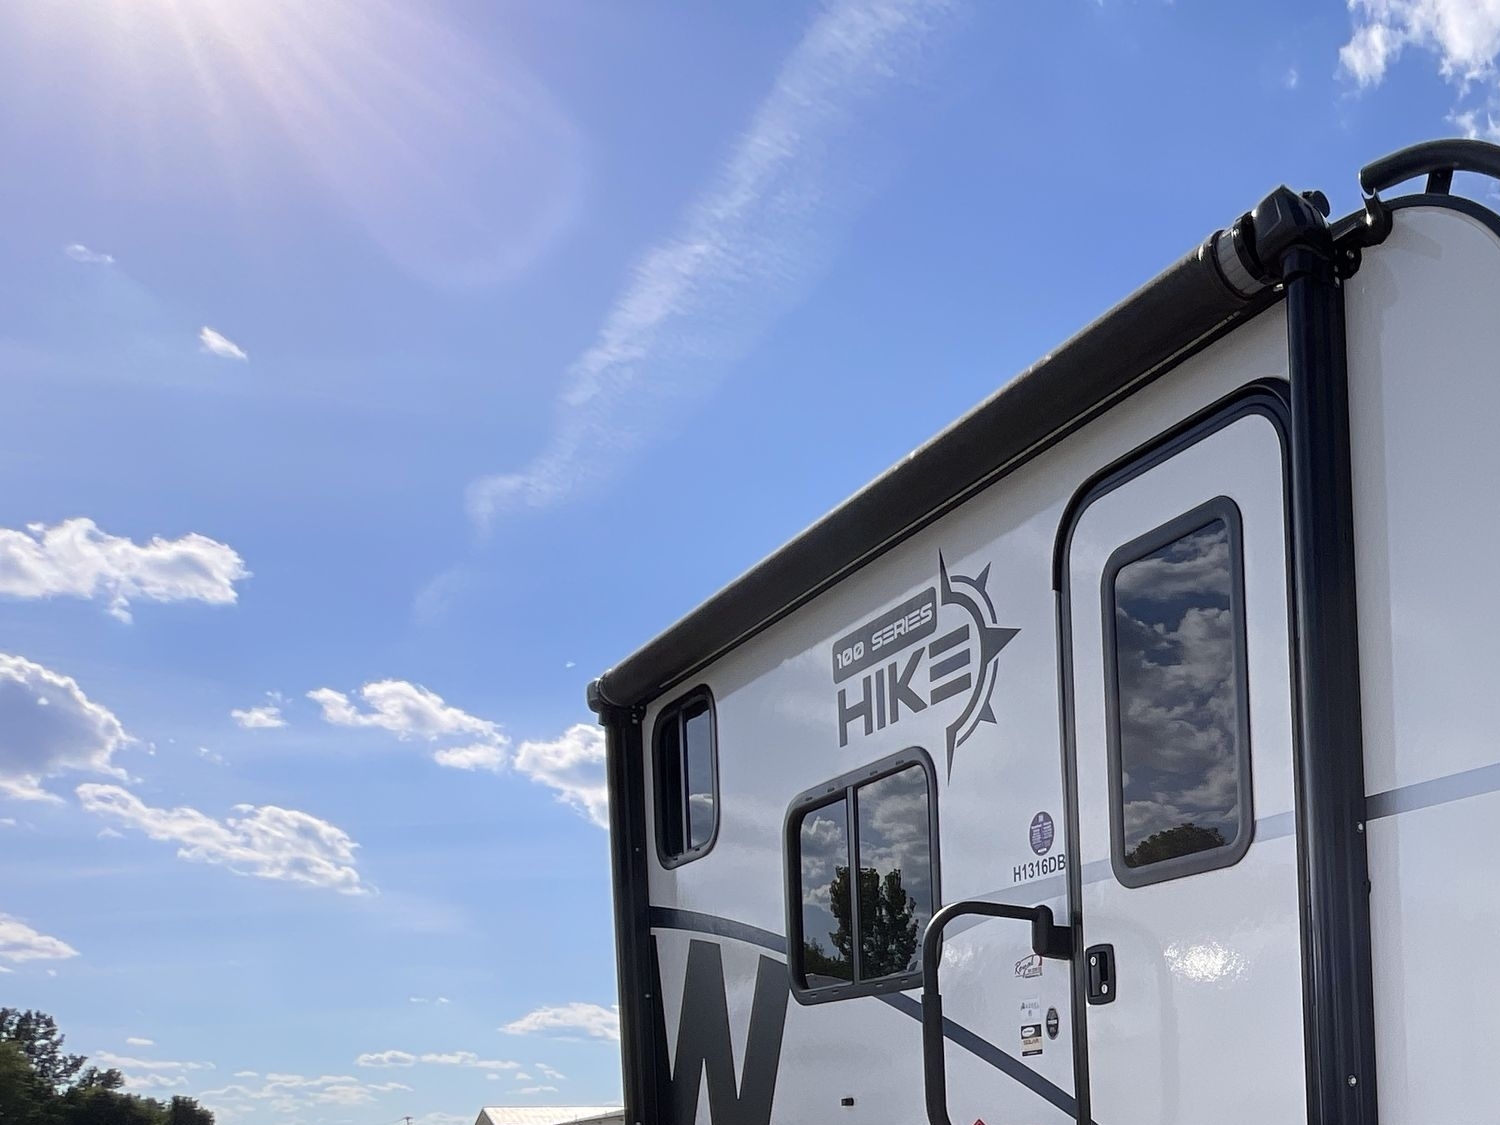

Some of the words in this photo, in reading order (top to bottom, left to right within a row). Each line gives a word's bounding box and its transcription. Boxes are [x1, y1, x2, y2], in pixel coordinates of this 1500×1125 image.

[836, 641, 865, 670] 100
[871, 602, 933, 652] SERIES
[837, 623, 972, 748] HIKE
[1013, 853, 1066, 883] H1316DB
